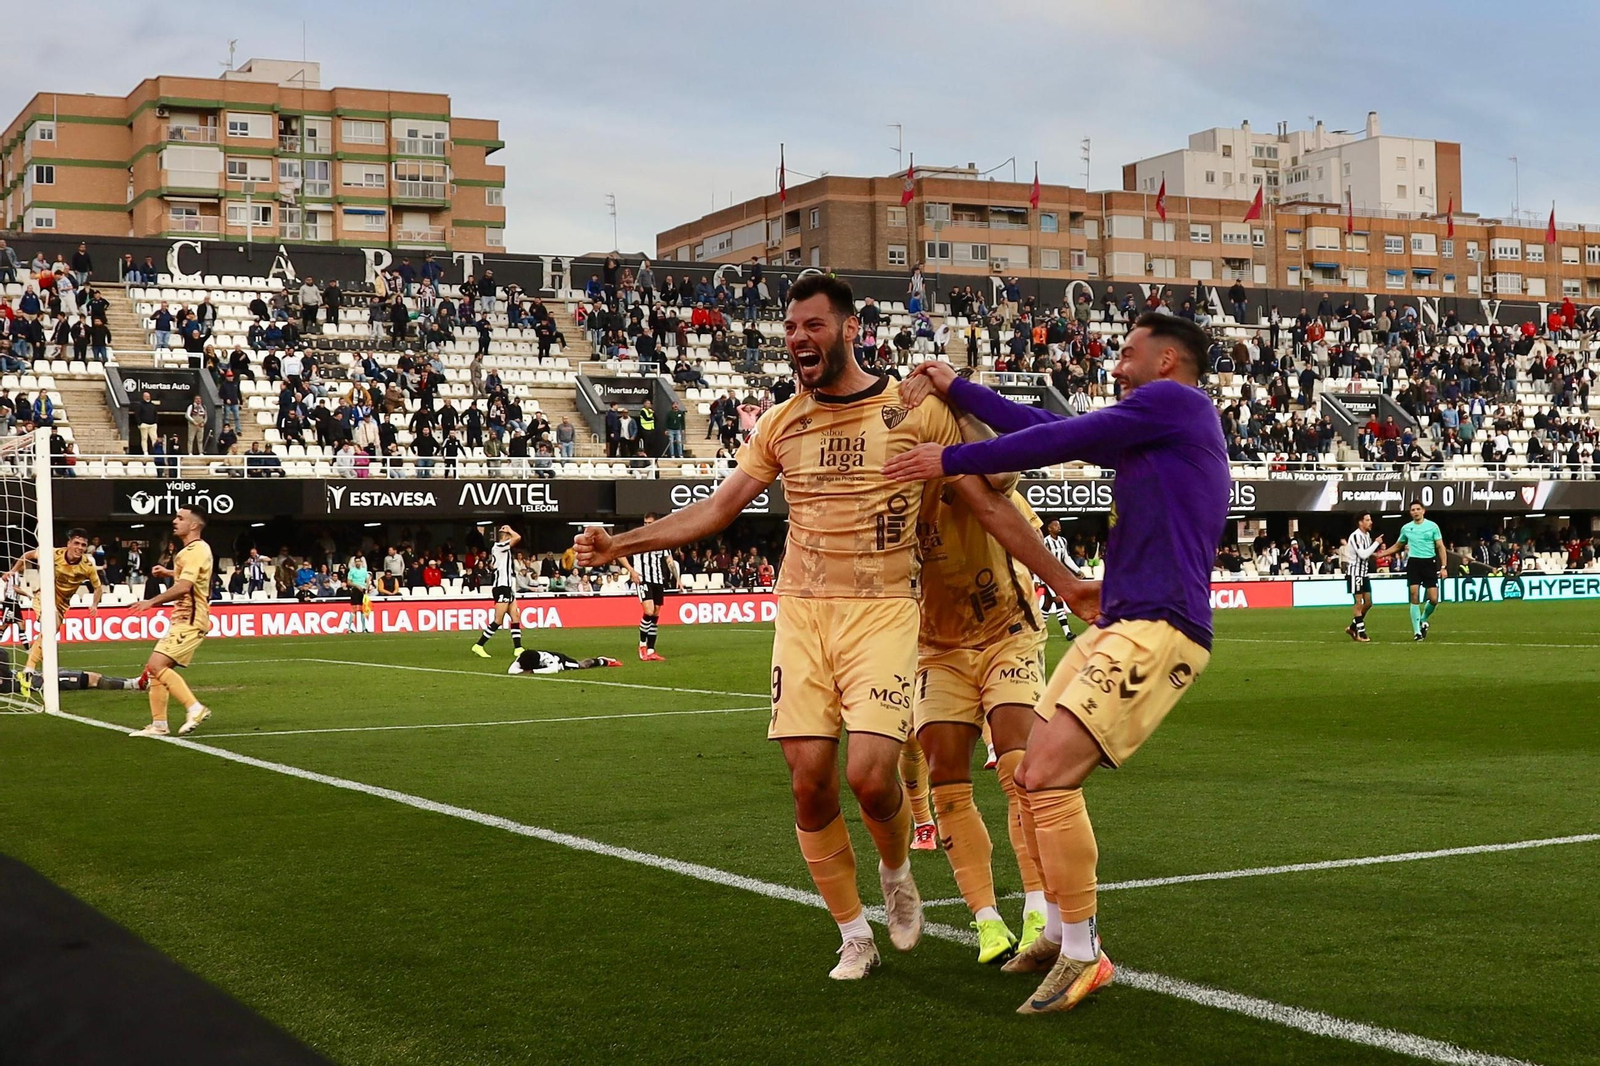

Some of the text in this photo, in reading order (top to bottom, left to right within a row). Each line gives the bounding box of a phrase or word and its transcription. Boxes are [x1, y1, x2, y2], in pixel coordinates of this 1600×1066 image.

[141, 382, 171, 390] Huertas
[171, 382, 190, 390] Auto
[827, 430, 866, 452] má
[819, 447, 865, 472] laga
[166, 481, 196, 492] viajes
[1294, 473, 1315, 481] PACO
[350, 492, 437, 506] ESTAVESA
[458, 483, 558, 505] AVATEL
[1027, 481, 1113, 506] estels
[1342, 491, 1354, 500] FC
[1421, 486, 1454, 506] 0 0
[1504, 581, 1521, 592] EA
[1529, 578, 1600, 597] HYPER
[679, 602, 756, 625] OBRAS
[206, 613, 254, 638] QUE
[262, 610, 375, 636] MARCAN
[382, 610, 413, 633] LA
[999, 667, 1039, 683] MGS
[869, 687, 911, 709] MGS
